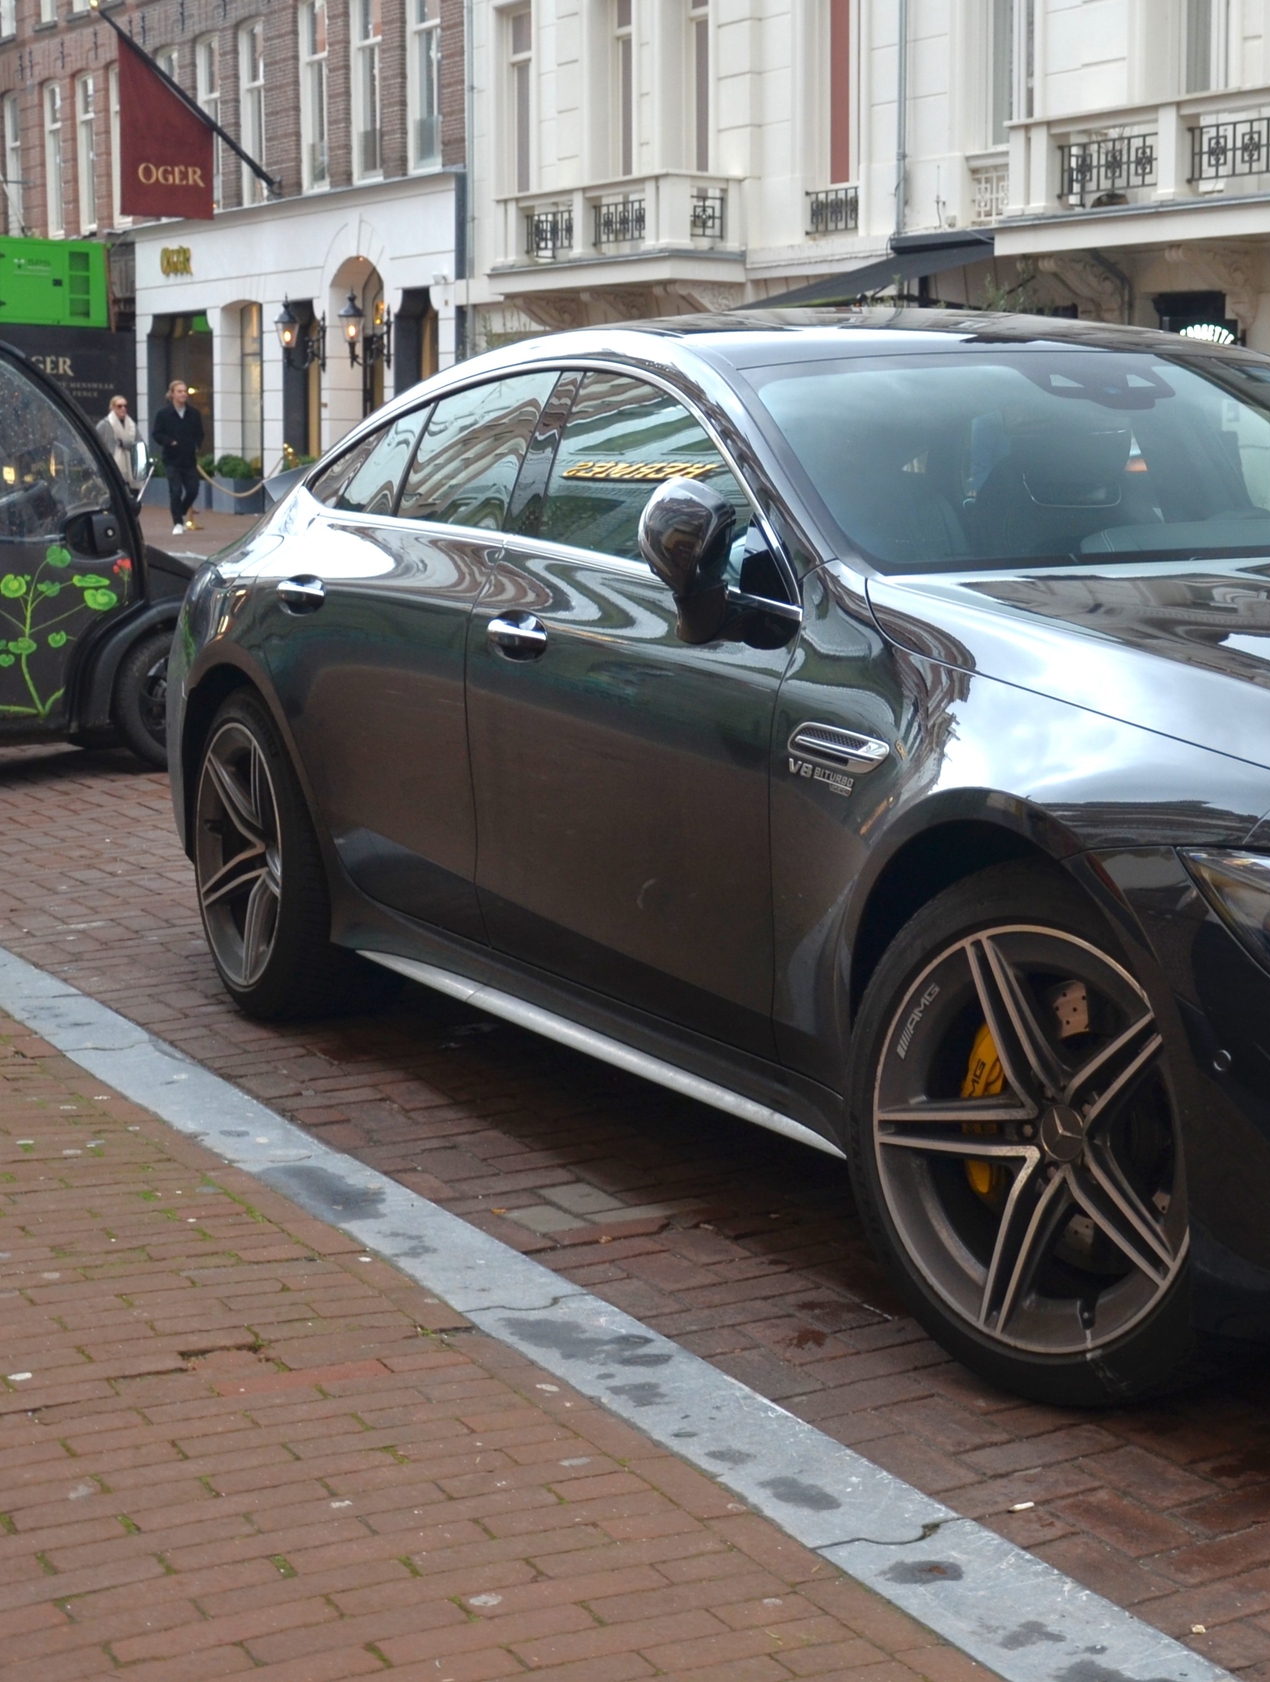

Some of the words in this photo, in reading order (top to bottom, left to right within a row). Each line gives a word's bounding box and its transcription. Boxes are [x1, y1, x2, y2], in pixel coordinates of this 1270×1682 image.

[138, 162, 205, 188] OGER
[31, 355, 75, 377] GER
[788, 757, 813, 778] V8
[813, 766, 855, 787] BITURBO
[967, 1058, 987, 1098] MG
